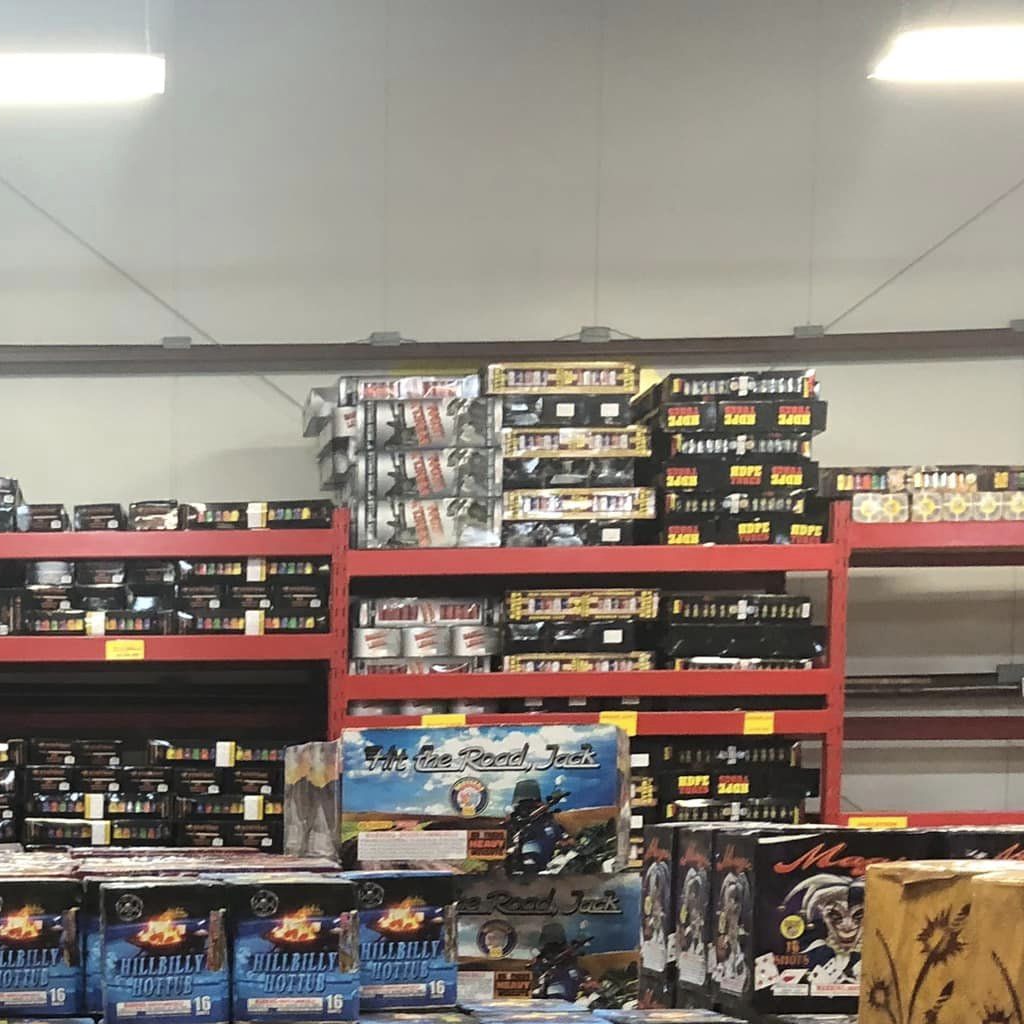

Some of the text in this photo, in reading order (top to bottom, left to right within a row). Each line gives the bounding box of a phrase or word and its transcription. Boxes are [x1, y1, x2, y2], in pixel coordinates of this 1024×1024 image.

[364, 744, 408, 771] Hit
[414, 744, 451, 771] the
[536, 743, 601, 771] Jack
[361, 940, 441, 961] HILLBILLY
[119, 954, 204, 977] HILLBILLY
[252, 952, 337, 973] HILLBILLY
[49, 988, 66, 1003] 16
[429, 980, 445, 995] 16
[195, 995, 211, 1012] 16
[326, 994, 343, 1010] 16
